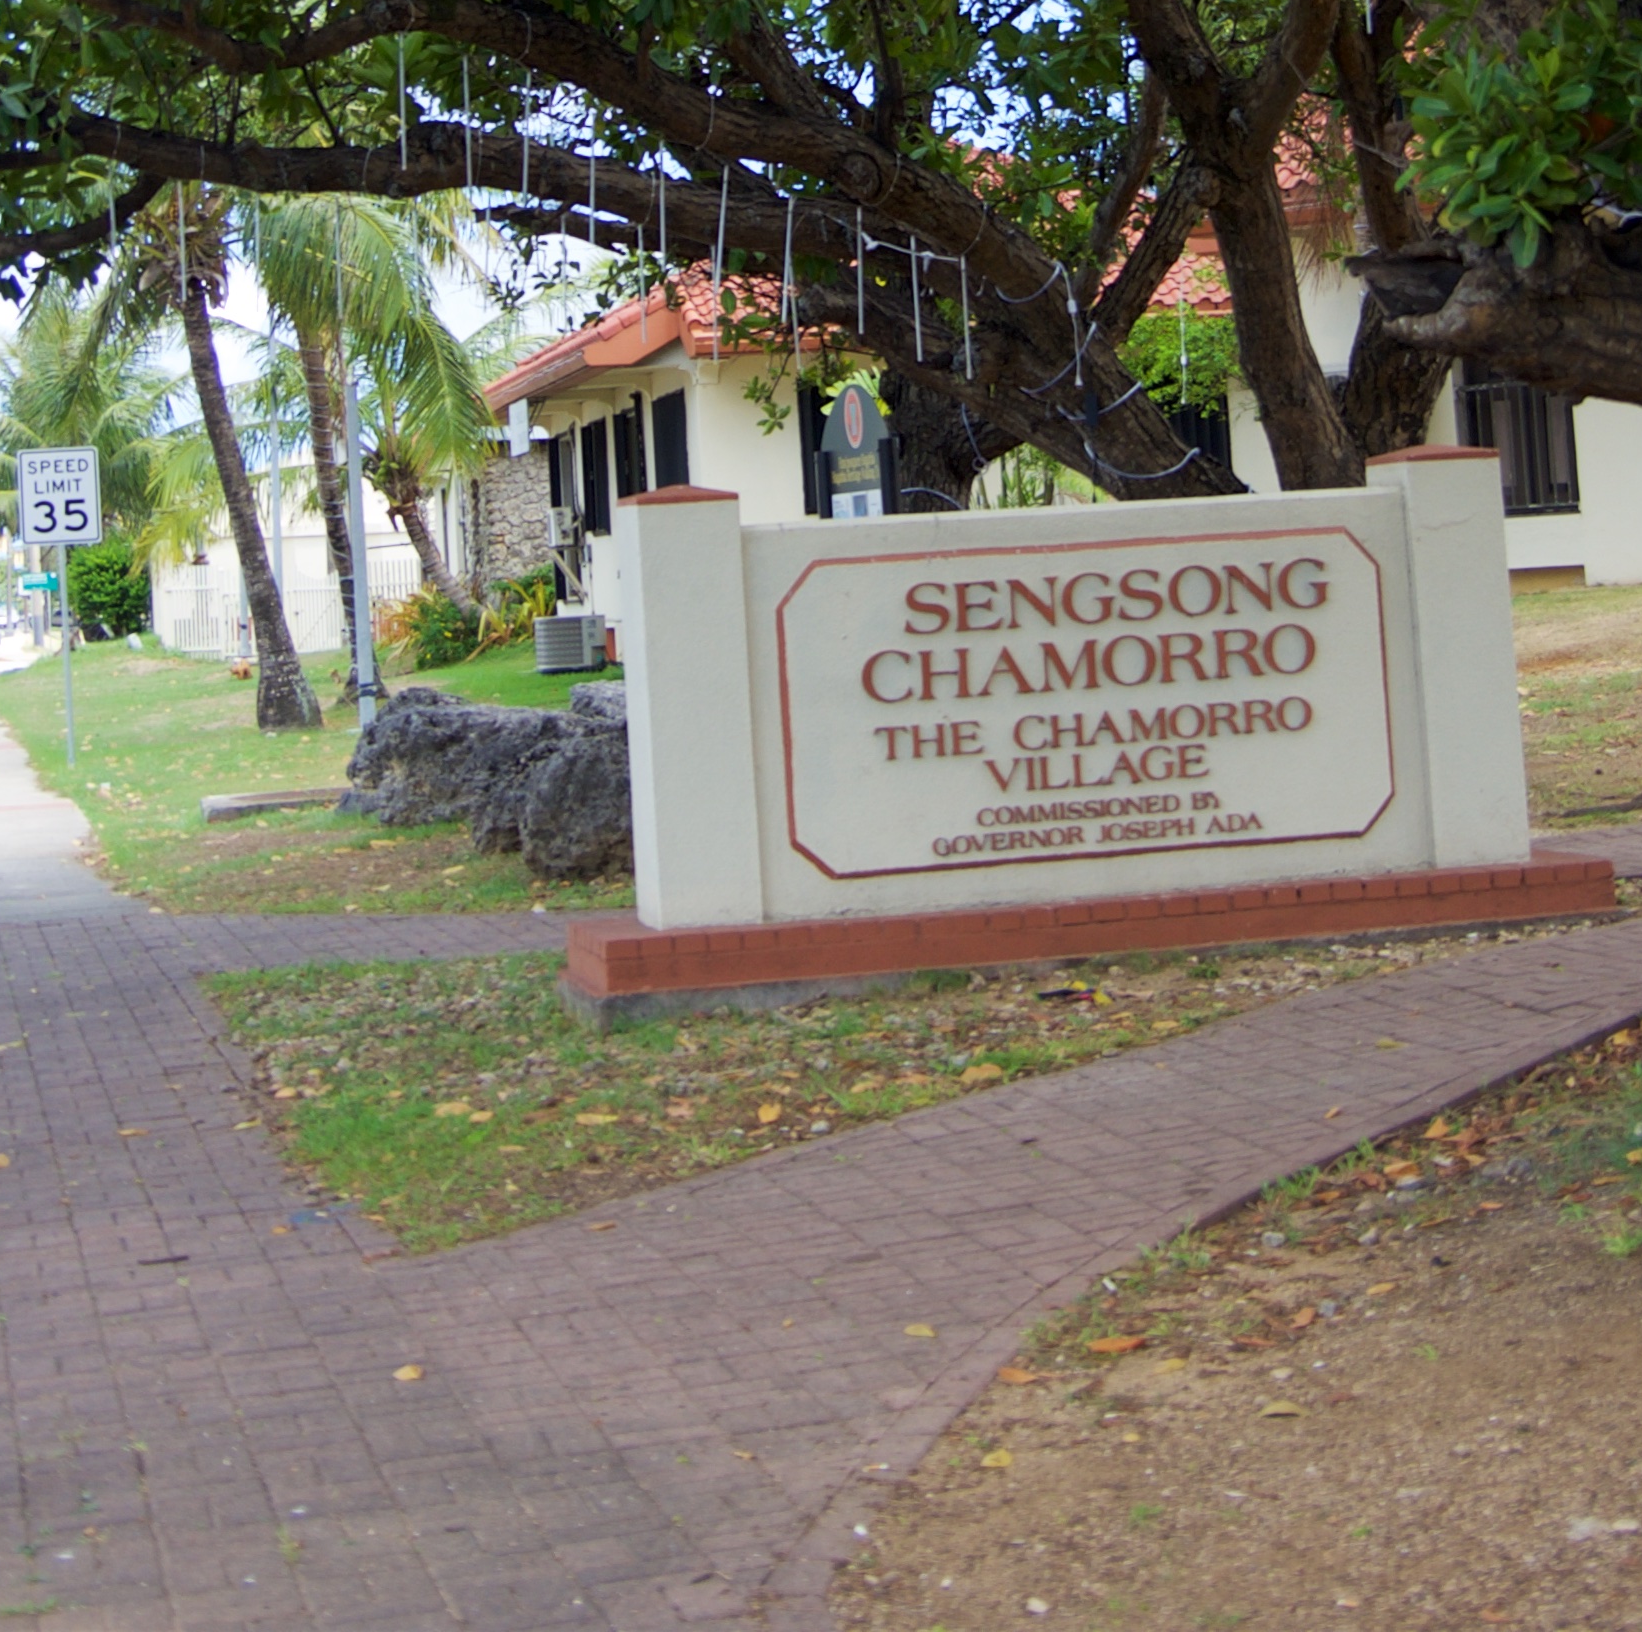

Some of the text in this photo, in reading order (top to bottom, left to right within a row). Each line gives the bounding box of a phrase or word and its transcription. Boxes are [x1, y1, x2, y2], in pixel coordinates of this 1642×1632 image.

[27, 458, 89, 475] SPEED
[34, 477, 83, 495] LIMIT
[33, 498, 89, 533] 35
[903, 557, 1330, 635] SENGSONG
[861, 623, 1316, 704] CHAMORRO
[873, 696, 1313, 761] THE CHAMORRO
[982, 743, 1211, 793] VILLAGE
[976, 793, 1181, 827] COMMISSIONED
[932, 812, 1263, 857] GOVERNOR JOSEPH ADA
